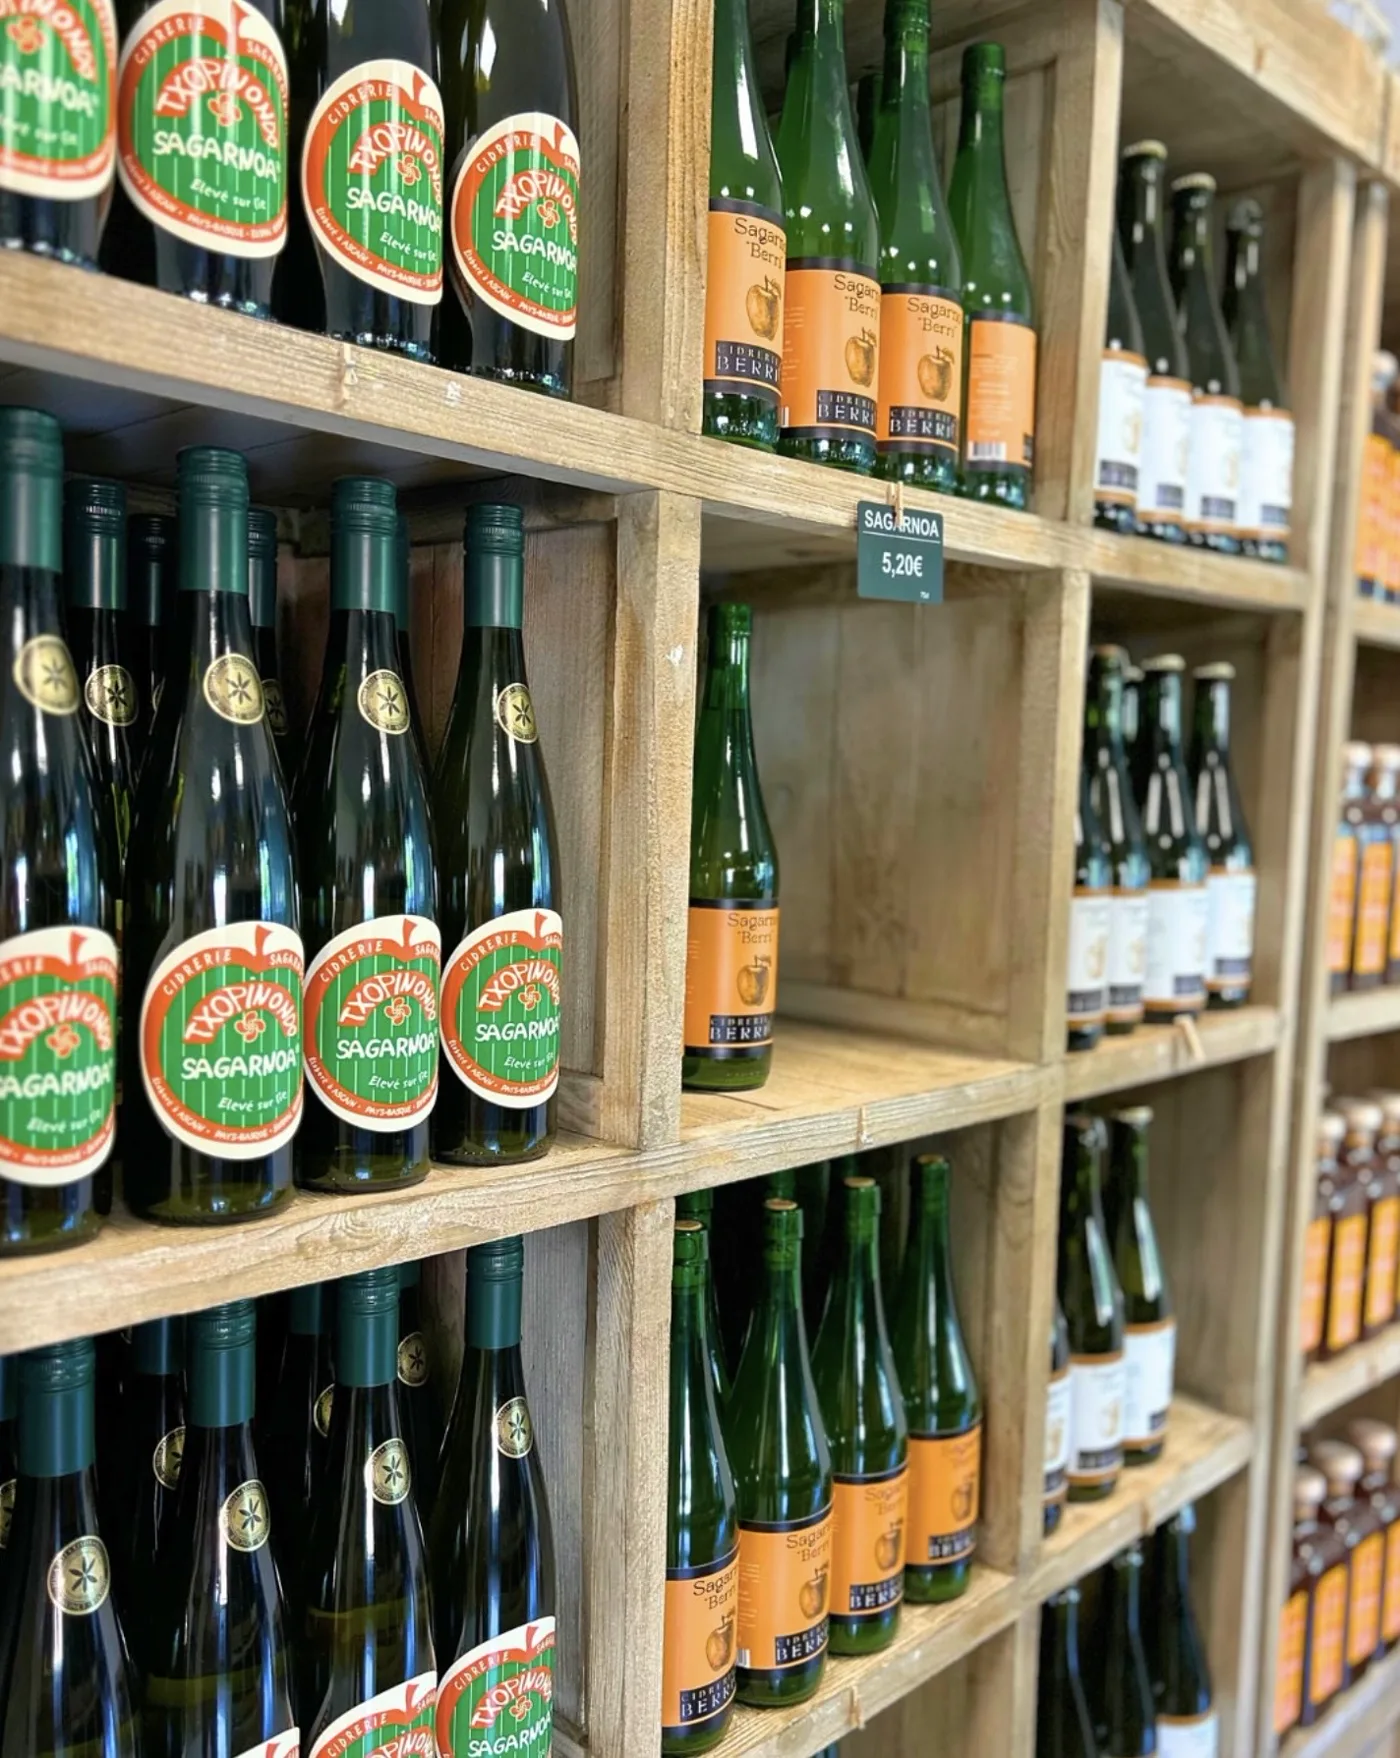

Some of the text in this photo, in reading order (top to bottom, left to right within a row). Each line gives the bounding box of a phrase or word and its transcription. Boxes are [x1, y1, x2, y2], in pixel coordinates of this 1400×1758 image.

[135, 16, 207, 64] CIDRERIE
[0, 62, 93, 118] ARNOA
[156, 58, 279, 149] TXOPINONDO
[328, 84, 393, 126] CIDRERIE
[152, 131, 278, 184] SAGARNOA
[349, 122, 443, 206] TXOPINONDO
[476, 134, 537, 174] CIDRERIE
[232, 195, 251, 210] sur
[345, 188, 441, 236] SAGARNOA
[491, 231, 577, 276] SAGARNOA
[717, 356, 778, 383] BERRI
[818, 404, 874, 426] BERRI
[889, 419, 951, 439] BERRI
[881, 551, 923, 578] 5,20€
[163, 948, 233, 996] CIDRERIE
[319, 941, 383, 983] CIDRERIE
[460, 933, 519, 972] CIDRERIE
[340, 972, 436, 1023] TXOPINONDO
[479, 961, 561, 1010] TXOPINONDO
[185, 982, 298, 1040] TXOPINONDO
[475, 1017, 560, 1042] SAGARNOA
[181, 1049, 297, 1080] SAGARNOA
[336, 1034, 436, 1060] SAGARNOA
[504, 1055, 531, 1069] Elevé
[369, 1075, 400, 1090] Elevé
[403, 1078, 417, 1089] sur
[217, 1096, 254, 1112] Elevé
[257, 1099, 274, 1111] sur
[454, 1651, 510, 1690] CIDRERIE
[327, 1712, 388, 1757] CIDRERIE
[468, 1711, 551, 1757] SAGARNOA
